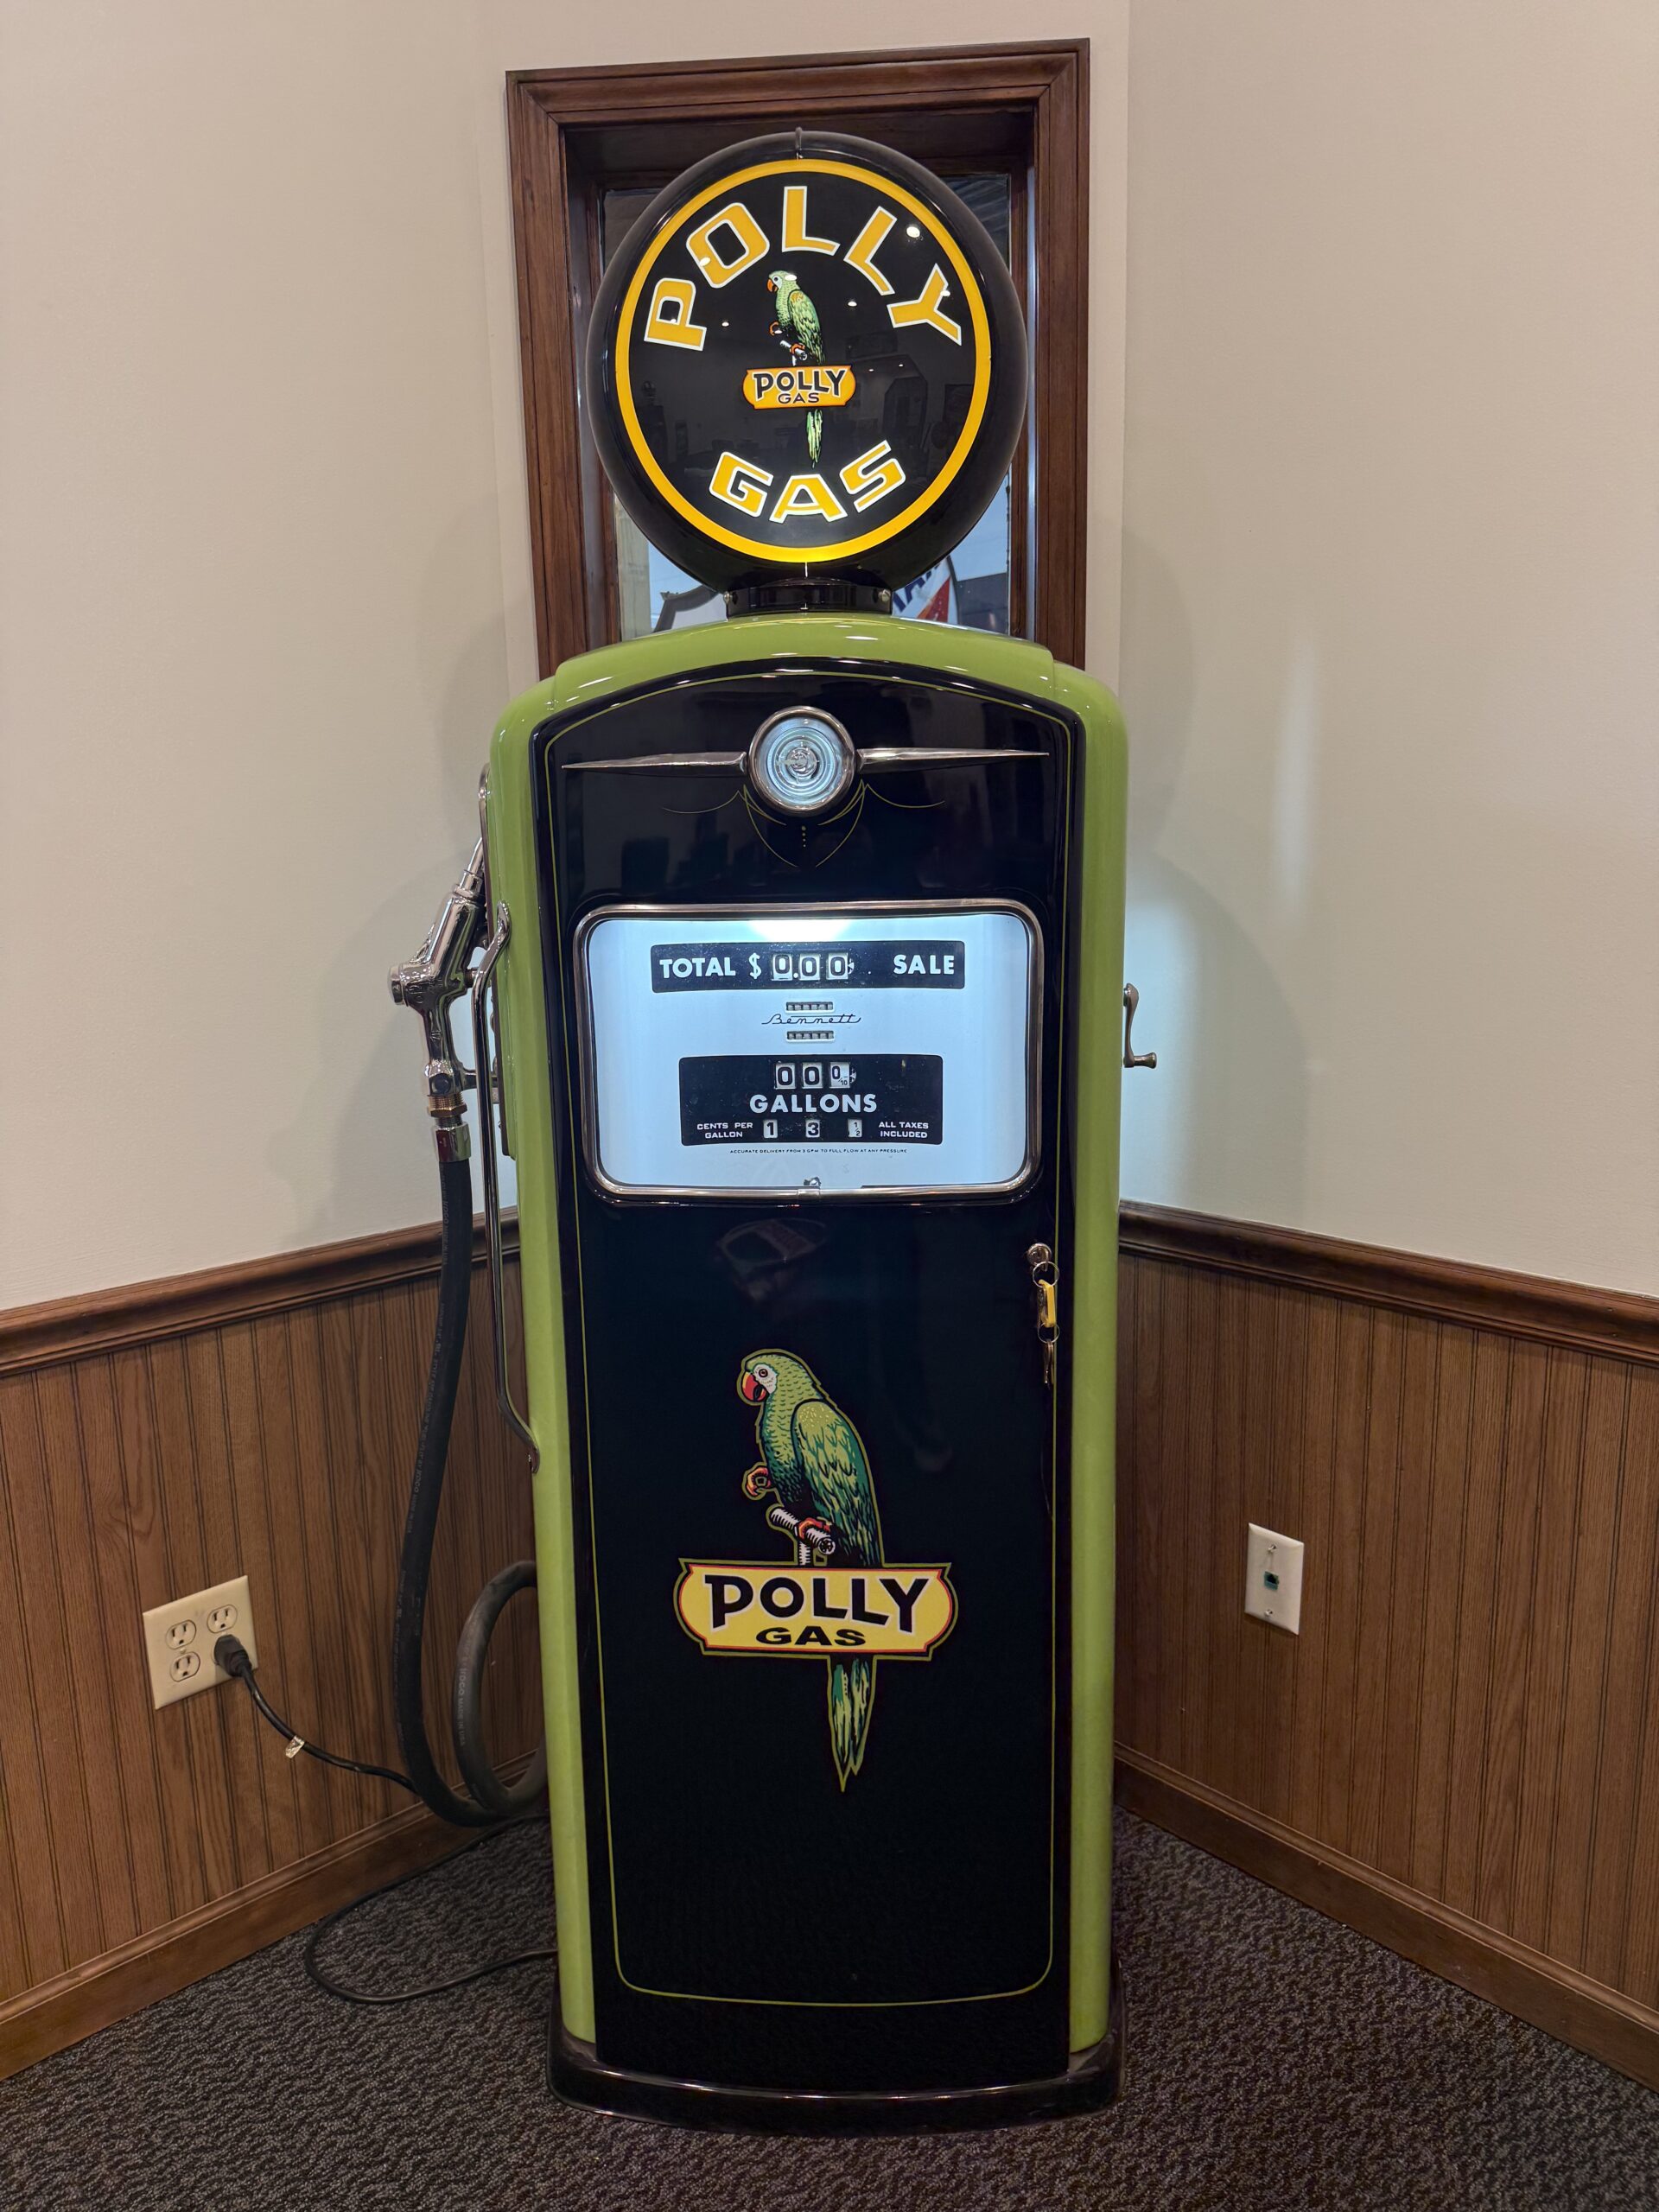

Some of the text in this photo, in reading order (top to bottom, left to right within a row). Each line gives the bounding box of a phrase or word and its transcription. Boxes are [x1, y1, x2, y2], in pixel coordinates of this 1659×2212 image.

[644, 185, 963, 352] POLLY
[753, 368, 848, 402] POLLY
[778, 392, 820, 404] GAS
[709, 439, 906, 524] GAS
[659, 957, 736, 979] TOTAL
[893, 954, 955, 976] SALE
[761, 1013, 861, 1025] Bennett
[749, 1093, 877, 1114] GALLONS
[696, 1122, 729, 1130] CENTS
[704, 1130, 743, 1139] GALLON
[807, 1122, 819, 1136] 3
[880, 1130, 928, 1139] INCLUDED
[703, 1573, 930, 1634] POLLY
[755, 1625, 867, 1647] GAS
